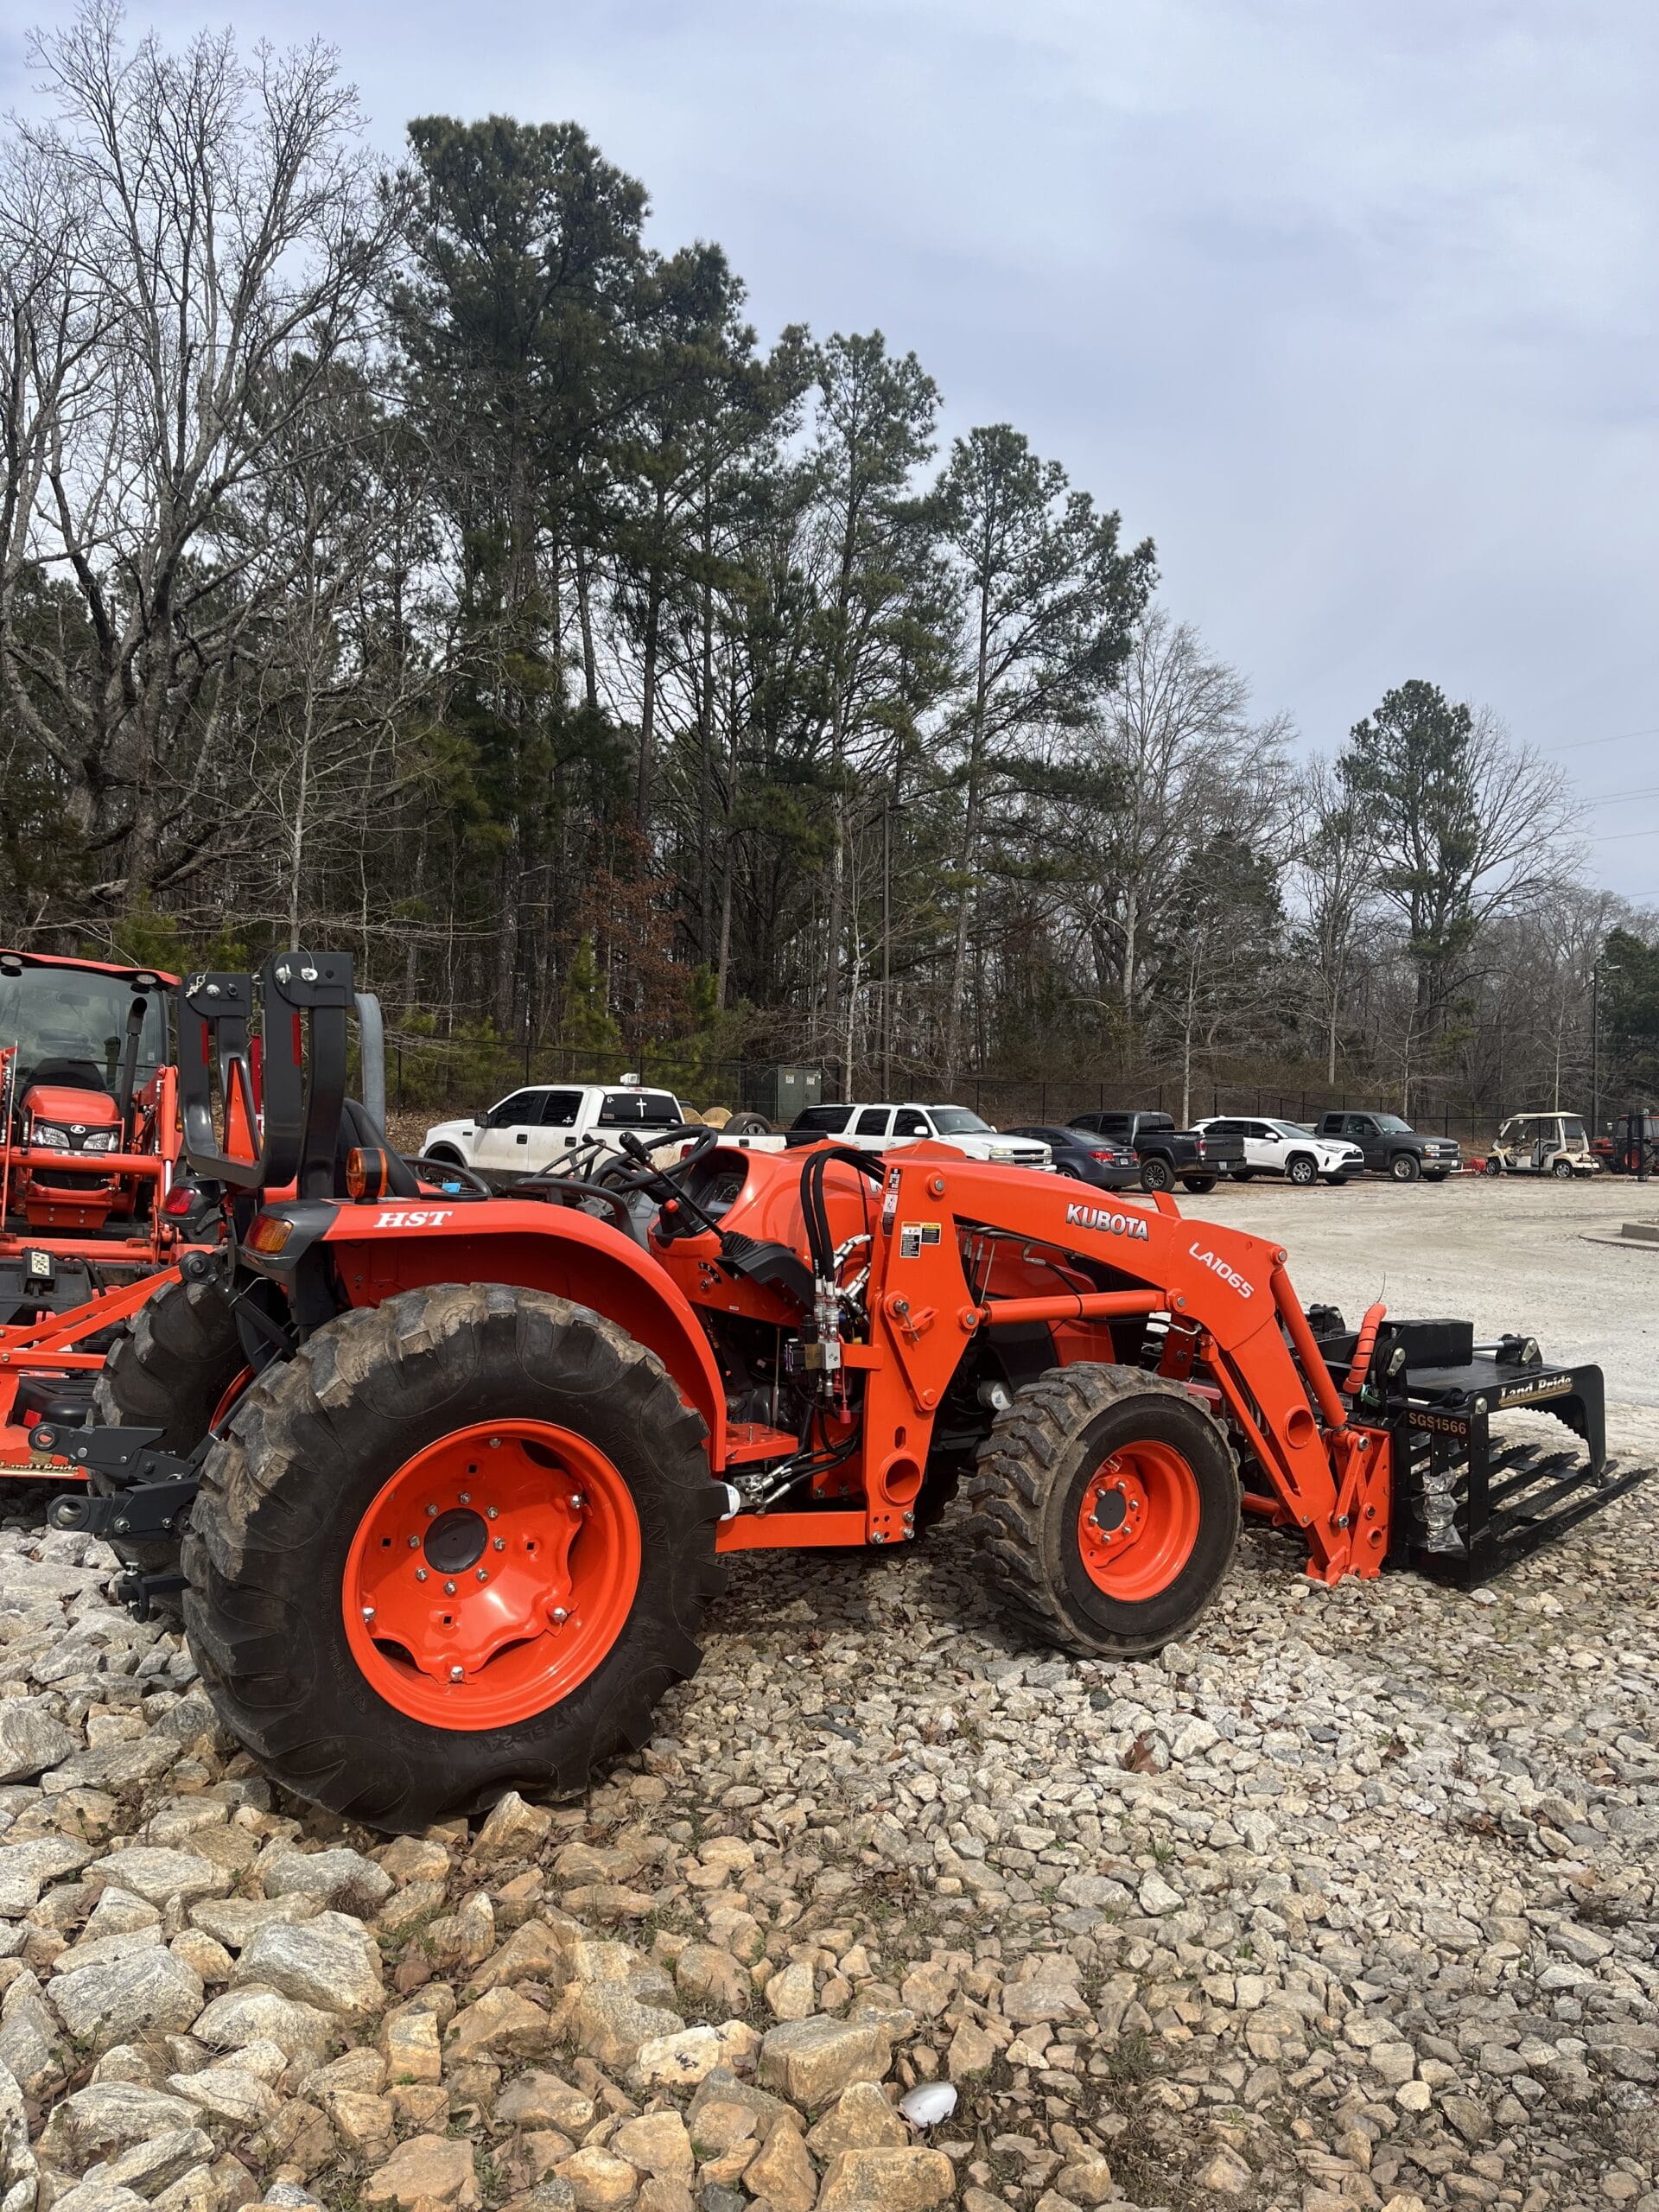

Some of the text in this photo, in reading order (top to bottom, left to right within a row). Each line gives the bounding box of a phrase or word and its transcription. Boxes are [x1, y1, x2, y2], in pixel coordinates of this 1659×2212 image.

[373, 1211, 453, 1228] HST
[1066, 1204, 1148, 1241] KUBOTA
[1188, 1242, 1255, 1300] LA1065
[1500, 1382, 1534, 1402] Land
[1408, 1412, 1466, 1434] SGS1566
[600, 1424, 669, 1549] TITAN
